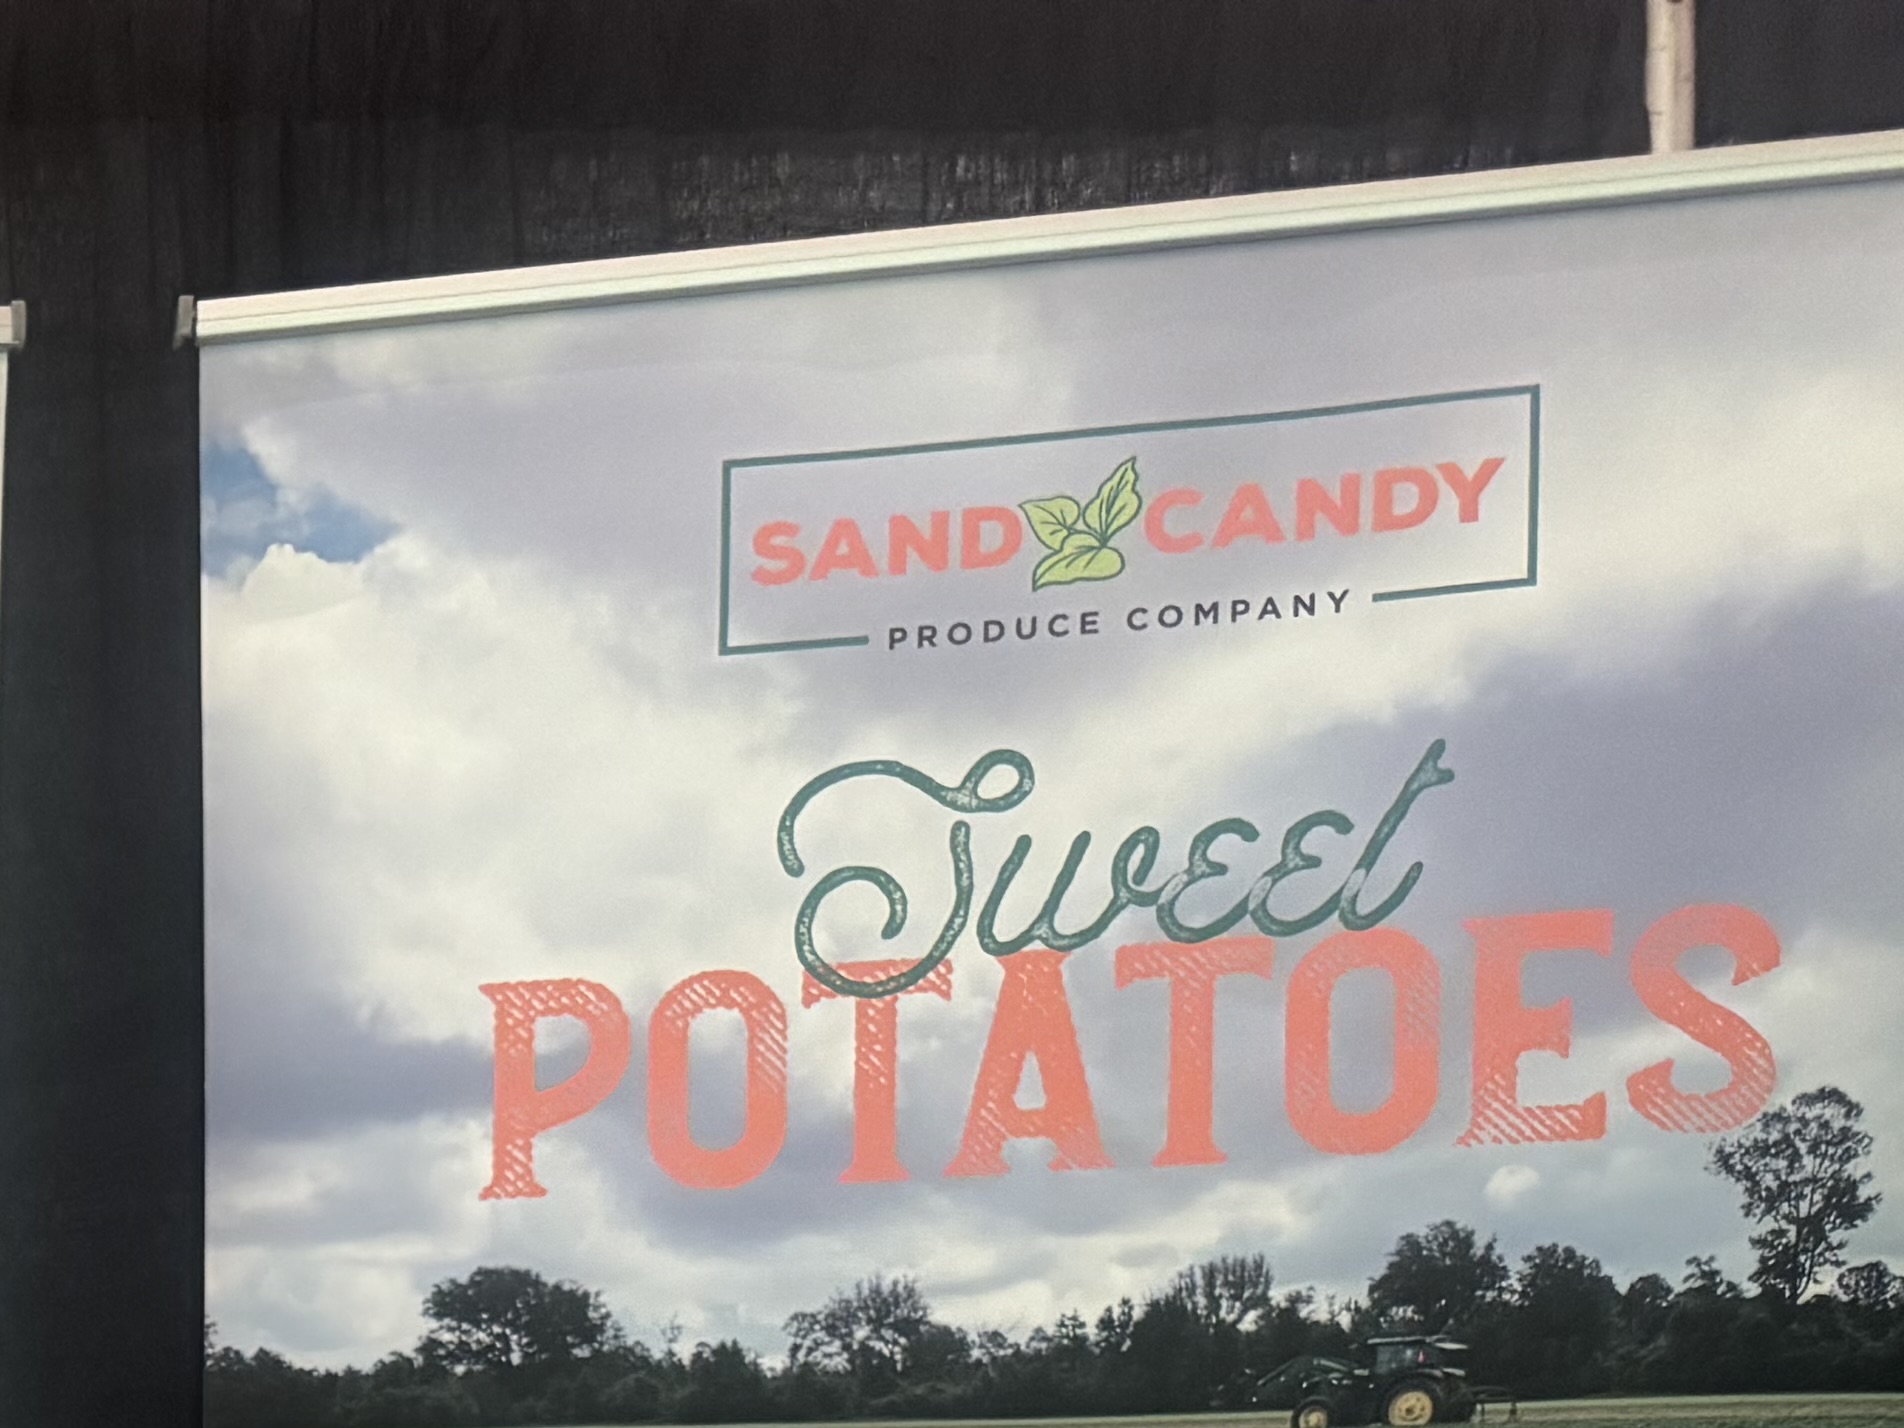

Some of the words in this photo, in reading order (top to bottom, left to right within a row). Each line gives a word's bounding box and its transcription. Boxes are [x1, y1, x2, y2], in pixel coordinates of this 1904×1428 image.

[750, 505, 1023, 587] SAND
[1142, 456, 1506, 553] CANDY
[886, 610, 1103, 651] PRODUCE
[1125, 588, 1354, 633] COMPANY
[779, 738, 1455, 999] Sweet
[477, 902, 1783, 1201] POTATOES
